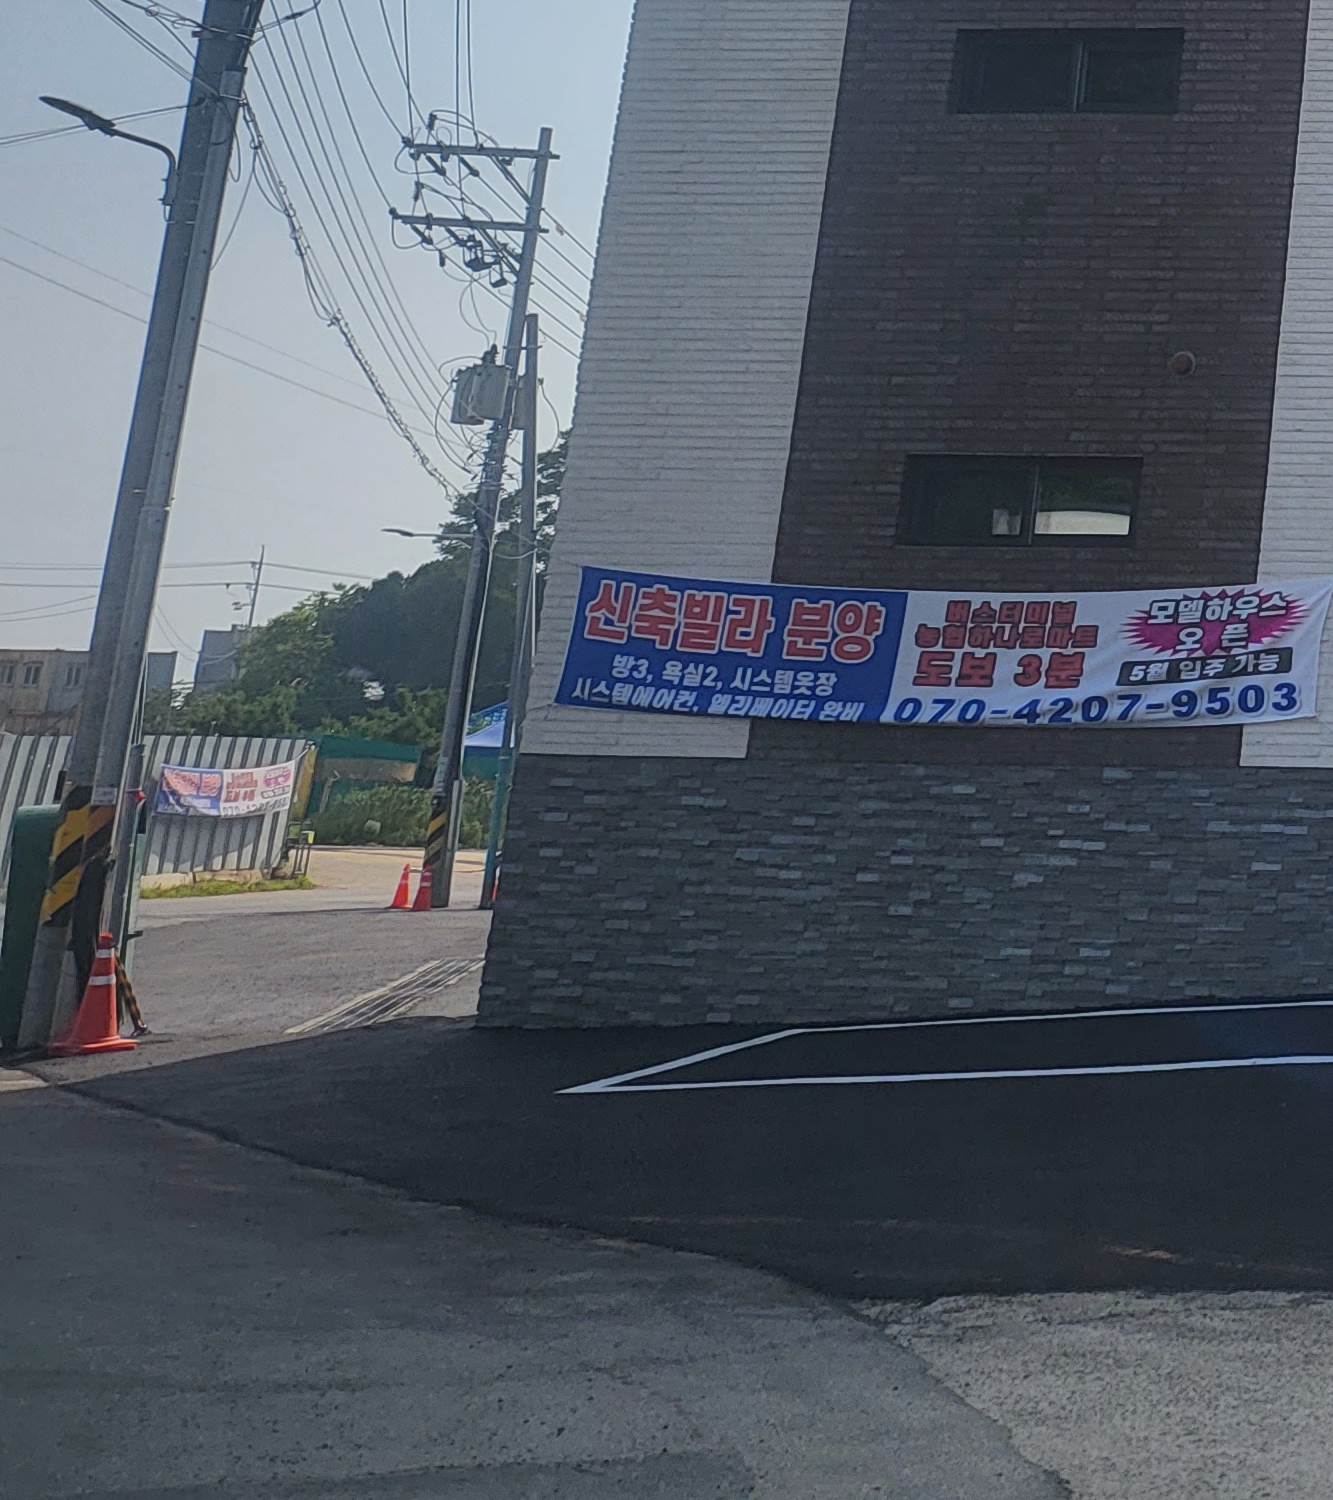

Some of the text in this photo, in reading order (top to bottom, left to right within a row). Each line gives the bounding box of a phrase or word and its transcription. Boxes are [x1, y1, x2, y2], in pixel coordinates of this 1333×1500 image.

[584, 580, 886, 664] 신축빌라 분양
[945, 600, 1078, 627] 버스터미널
[1147, 592, 1288, 624] 모델하우스
[914, 623, 1100, 650] 농협하나로마트
[611, 654, 838, 696] 방3, 욕실2, 시스템옷장
[912, 650, 1086, 689] 도보 3분
[1128, 652, 1281, 682] 5월 입주 가능
[819, 701, 865, 722] 완비
[893, 682, 1298, 725] 070-4207-9503
